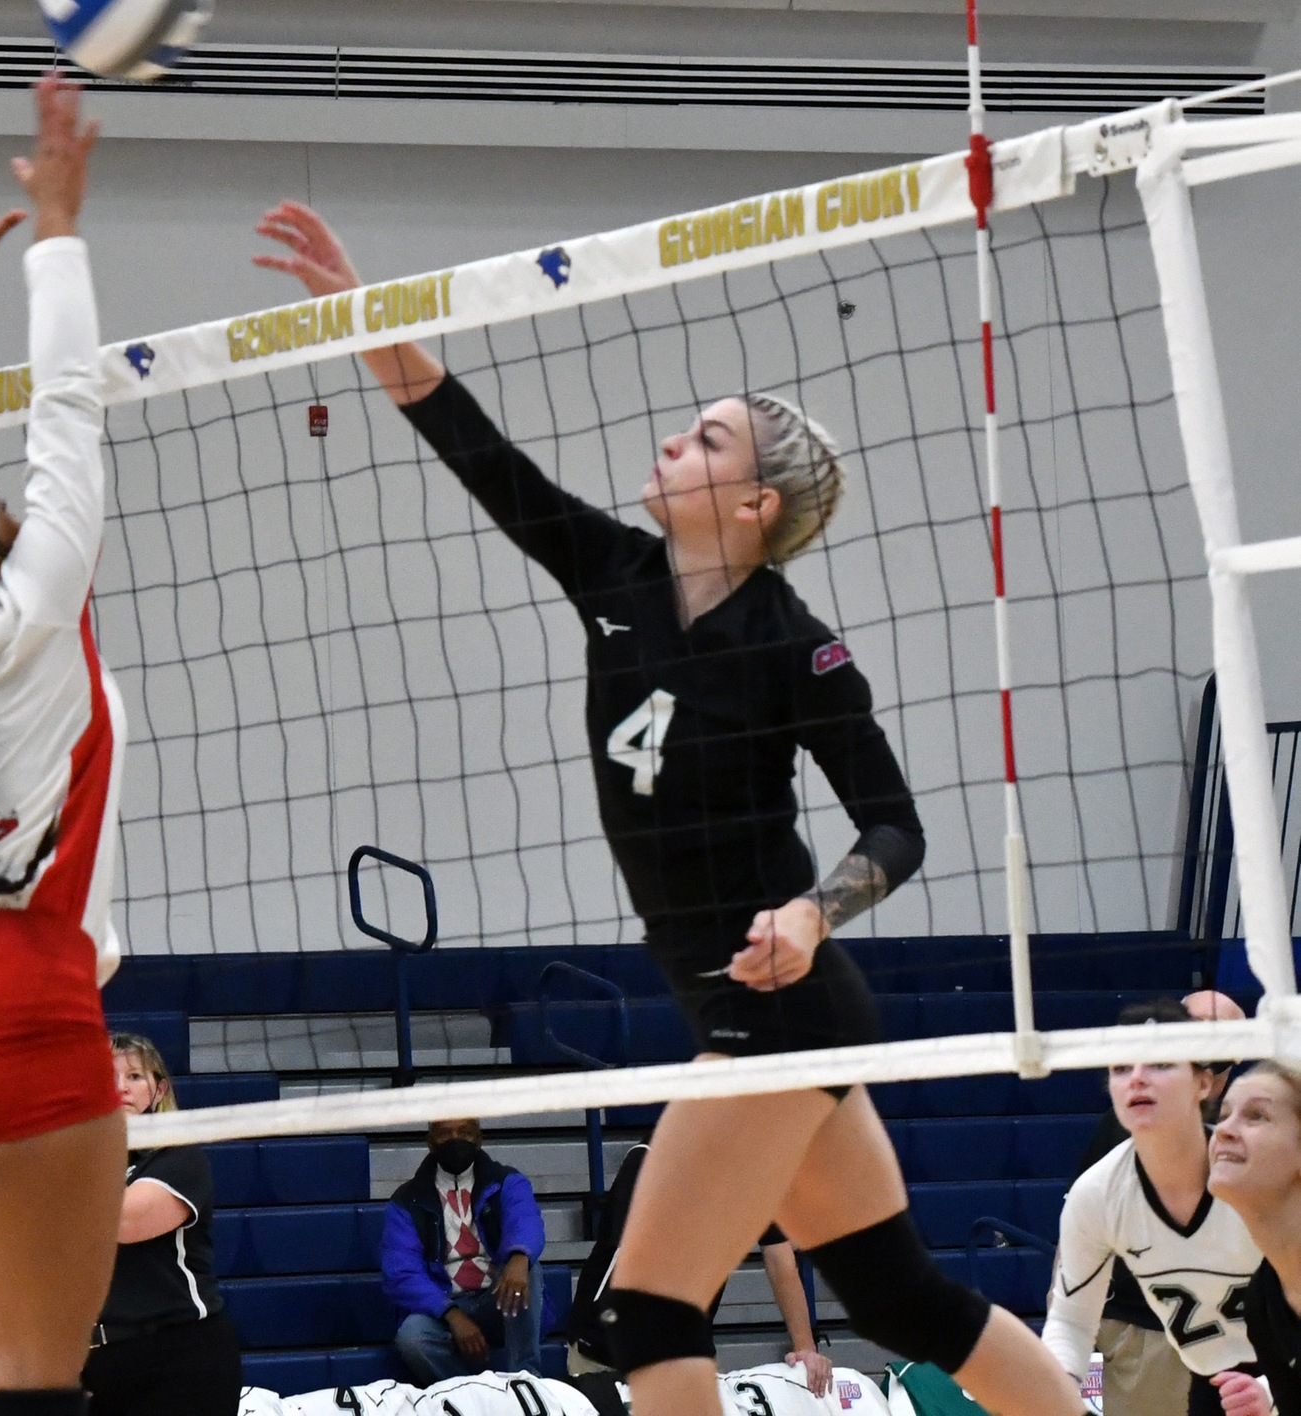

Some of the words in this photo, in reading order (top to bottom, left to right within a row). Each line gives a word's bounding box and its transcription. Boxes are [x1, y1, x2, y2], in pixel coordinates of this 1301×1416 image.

[658, 189, 805, 268] GEORGIAN
[816, 164, 922, 232] COURT
[227, 293, 354, 363] GEORGIAN
[364, 271, 455, 333] COURT
[607, 688, 676, 797] 4
[334, 1385, 364, 1416] 4
[734, 1381, 776, 1416] 3
